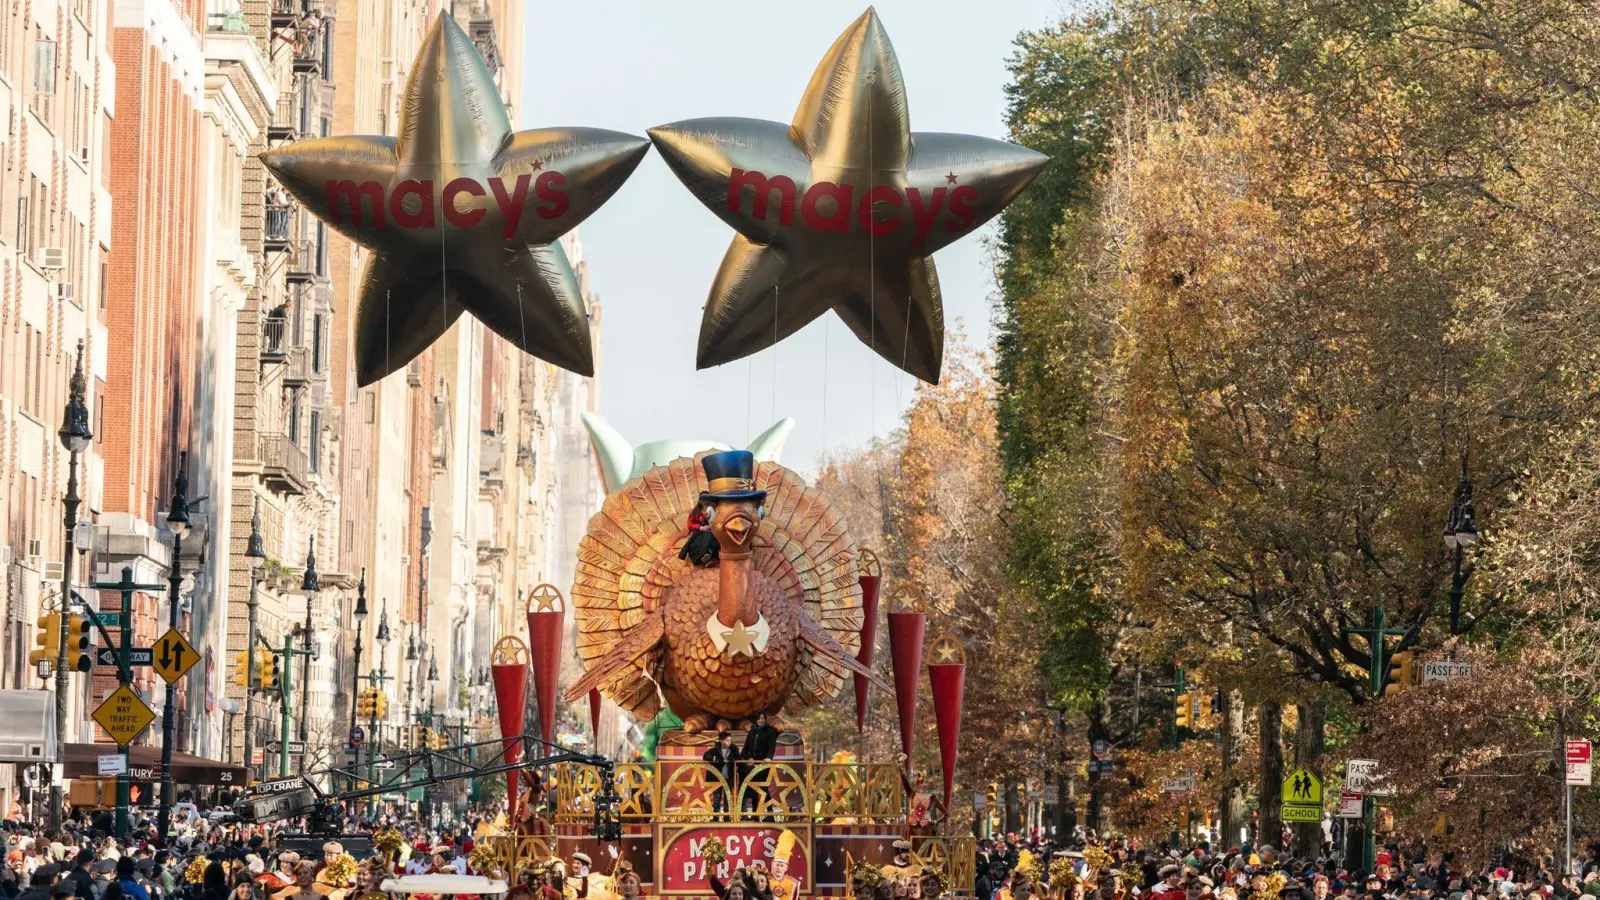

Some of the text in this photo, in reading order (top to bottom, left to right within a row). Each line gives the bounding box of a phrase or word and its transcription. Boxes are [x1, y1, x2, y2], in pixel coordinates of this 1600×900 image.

[1426, 664, 1472, 676] PASSEGE
[109, 715, 138, 723] TRAFFIC
[129, 768, 153, 778] TURY
[221, 772, 234, 781] 25
[273, 780, 304, 791] CRANE
[1284, 808, 1318, 818] SCHOOL
